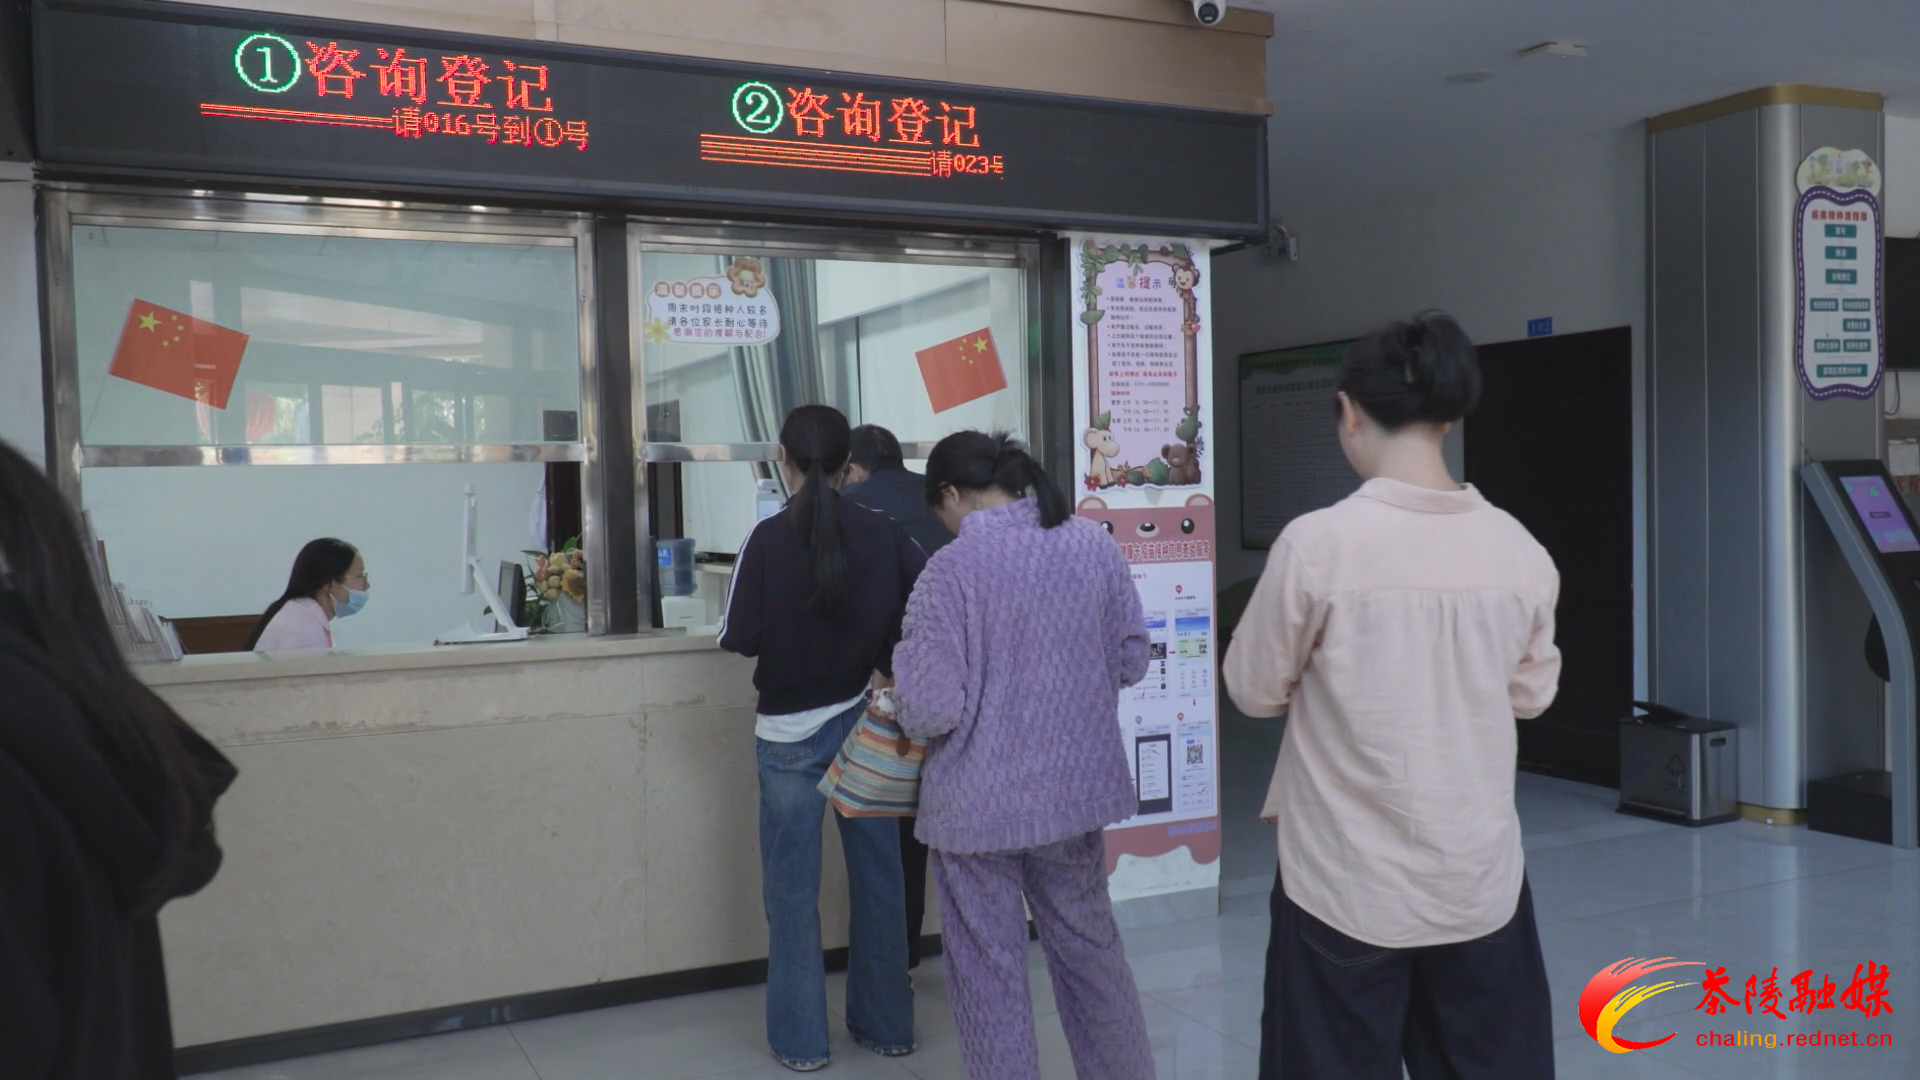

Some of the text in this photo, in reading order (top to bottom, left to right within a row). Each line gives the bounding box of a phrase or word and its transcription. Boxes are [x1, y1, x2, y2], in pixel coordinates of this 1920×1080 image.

[391, 105, 590, 152] 请016号到①号
[667, 302, 768, 316] 周末时段接种人较多
[667, 316, 768, 329] 请各位家长耐心等待
[673, 327, 767, 339] 感谢您的理解与配合！
